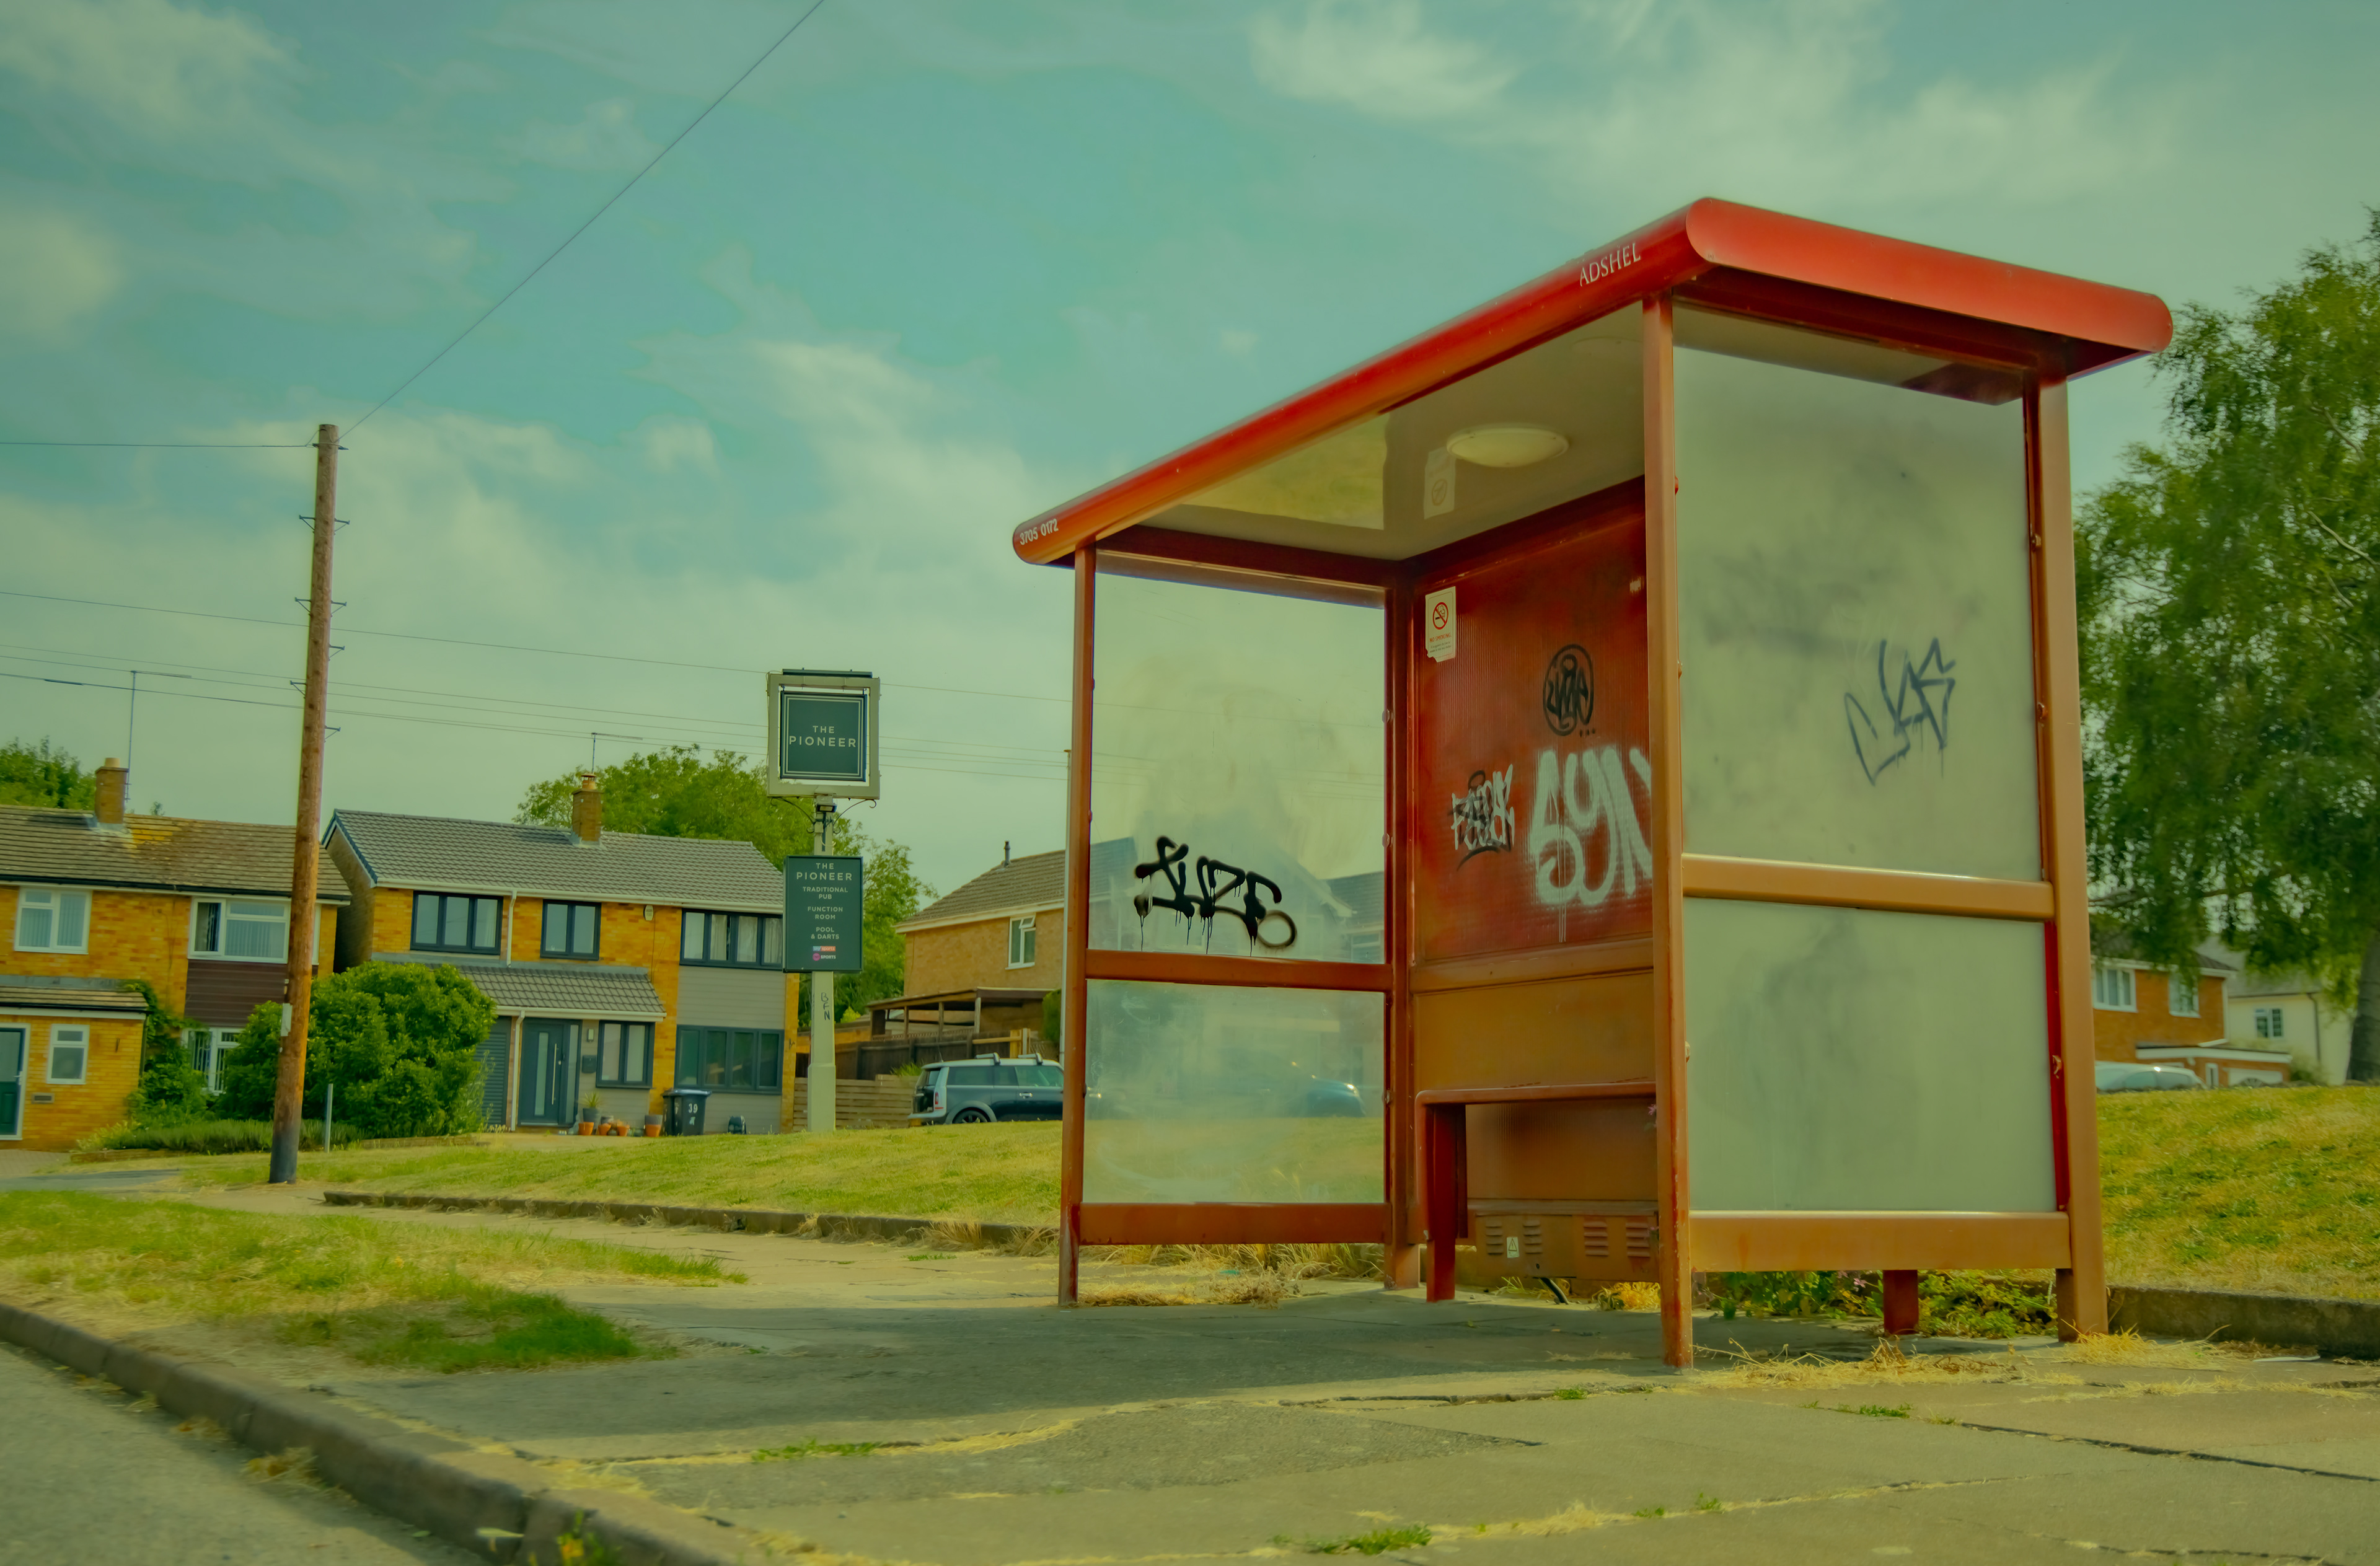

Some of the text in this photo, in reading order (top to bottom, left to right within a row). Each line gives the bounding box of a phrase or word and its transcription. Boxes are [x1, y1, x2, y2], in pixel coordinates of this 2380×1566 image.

[1580, 242, 1641, 287] ADSHEL
[1020, 518, 1059, 545] 3705 0172
[813, 726, 835, 734] THE
[789, 736, 857, 748] PIONEER
[796, 872, 852, 881] PIONEER
[689, 1103, 698, 1114] 39
